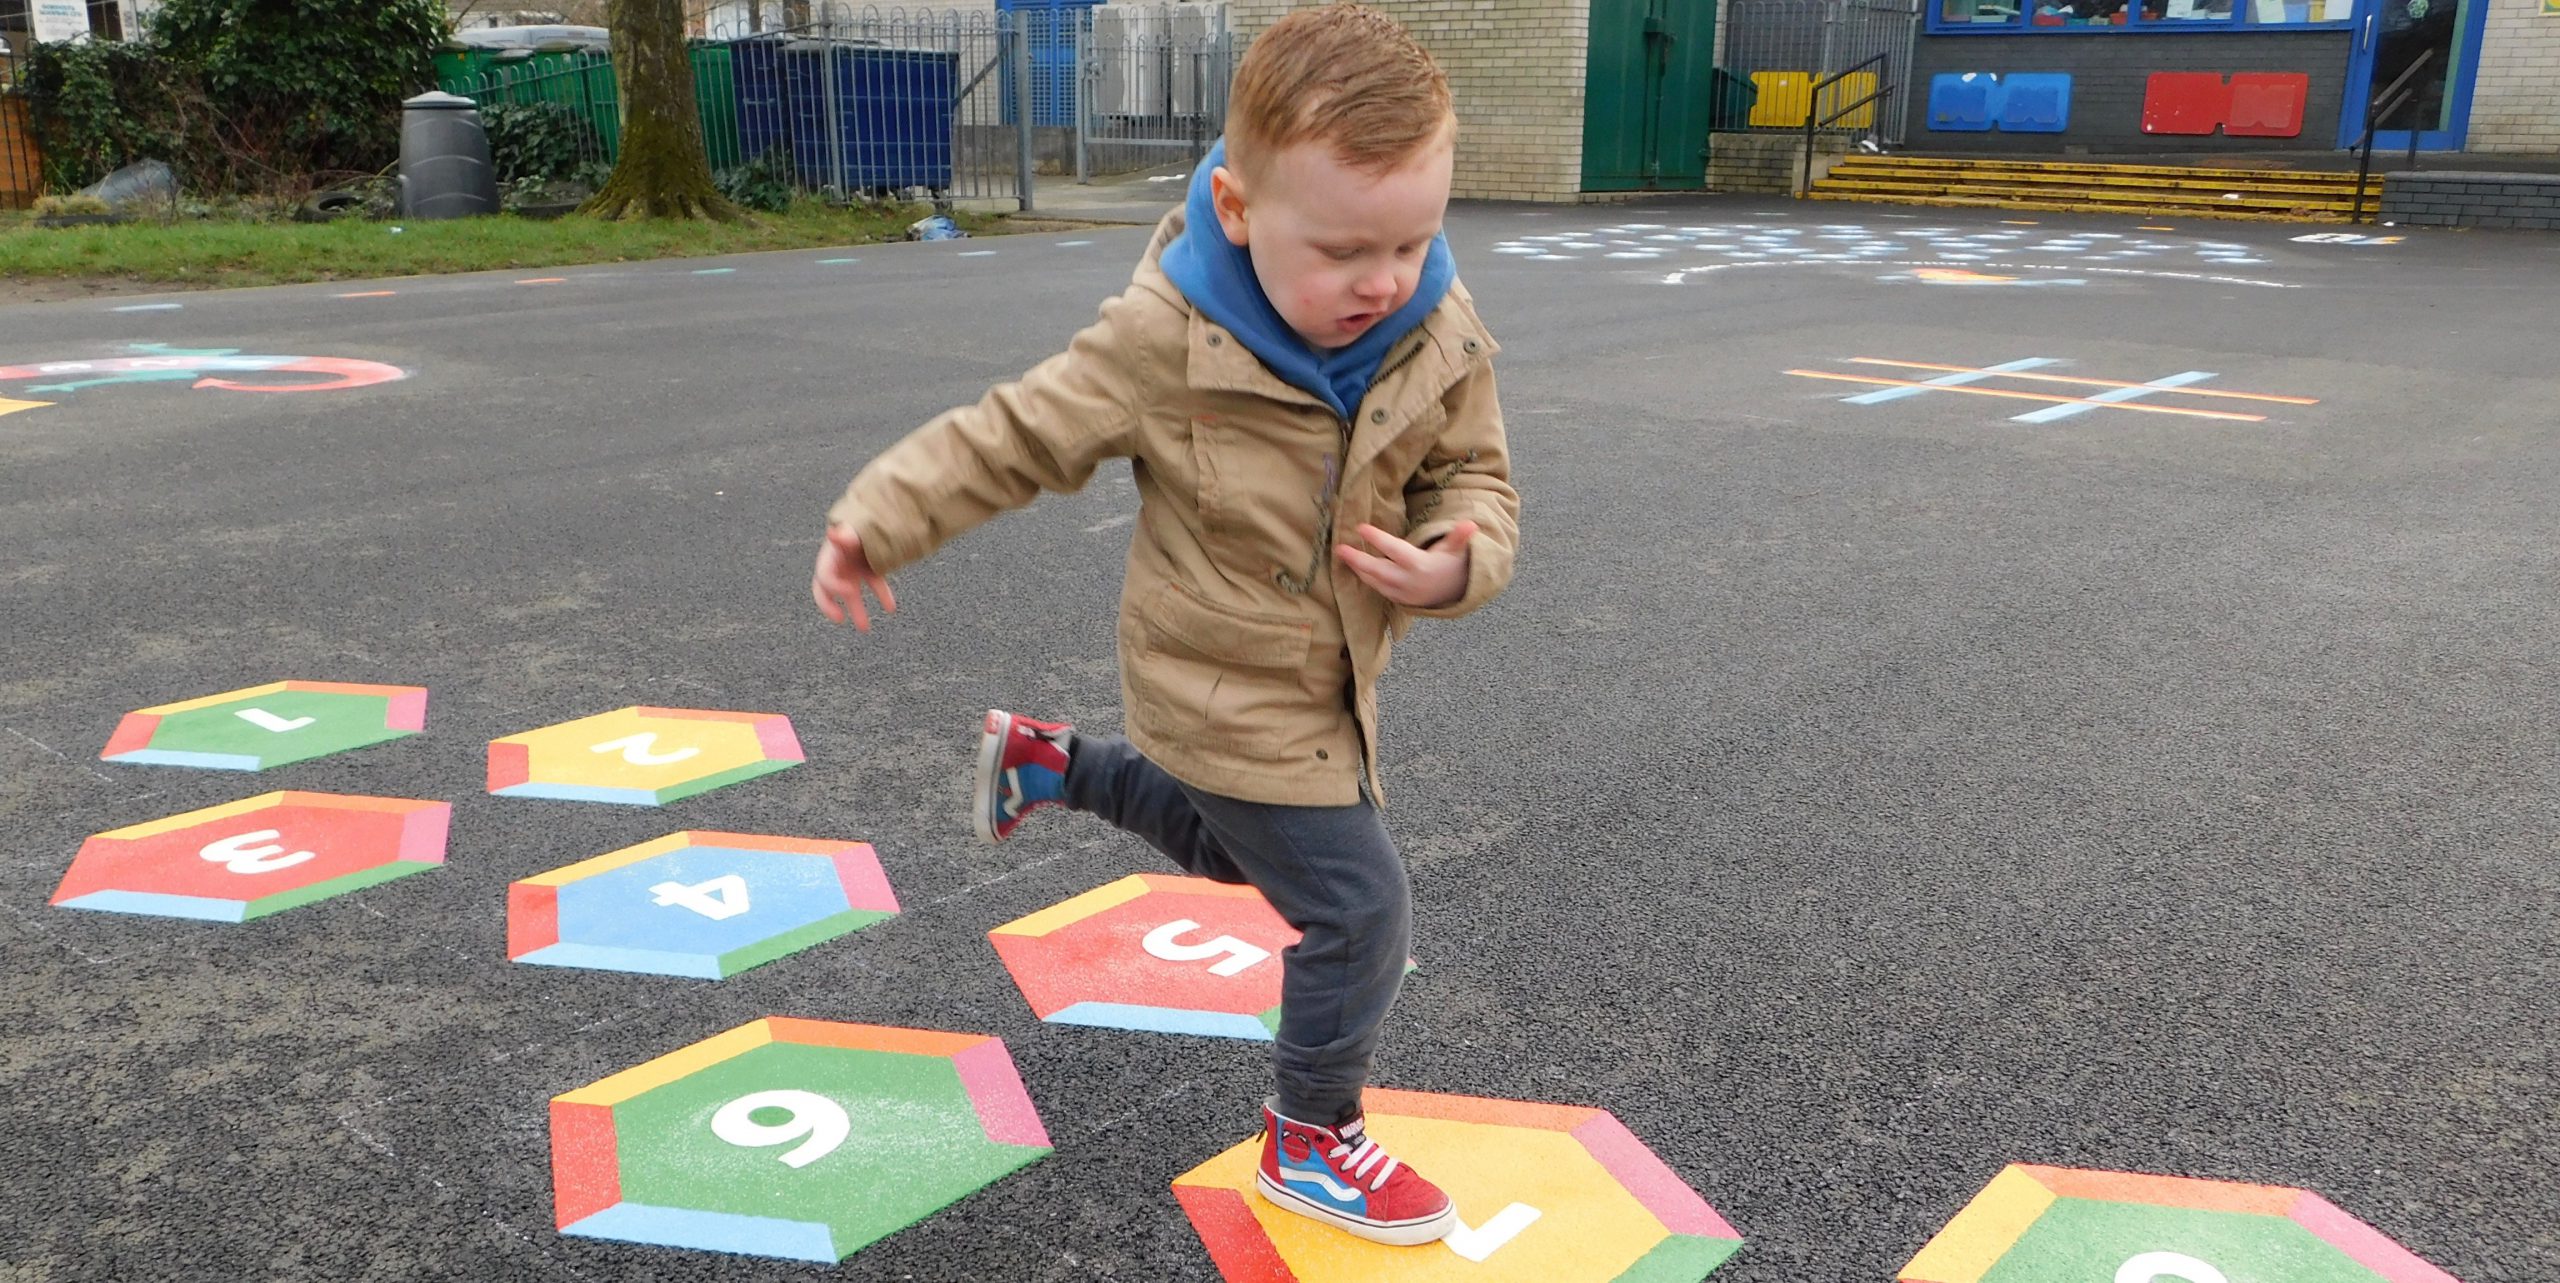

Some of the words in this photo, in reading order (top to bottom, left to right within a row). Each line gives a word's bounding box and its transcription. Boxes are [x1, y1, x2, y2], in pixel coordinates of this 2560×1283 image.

[234, 707, 316, 733] 1
[590, 731, 701, 766] 2
[199, 829, 316, 875] 3
[648, 873, 751, 920] 4
[1142, 919, 1271, 977] 5
[711, 1090, 851, 1169] 6
